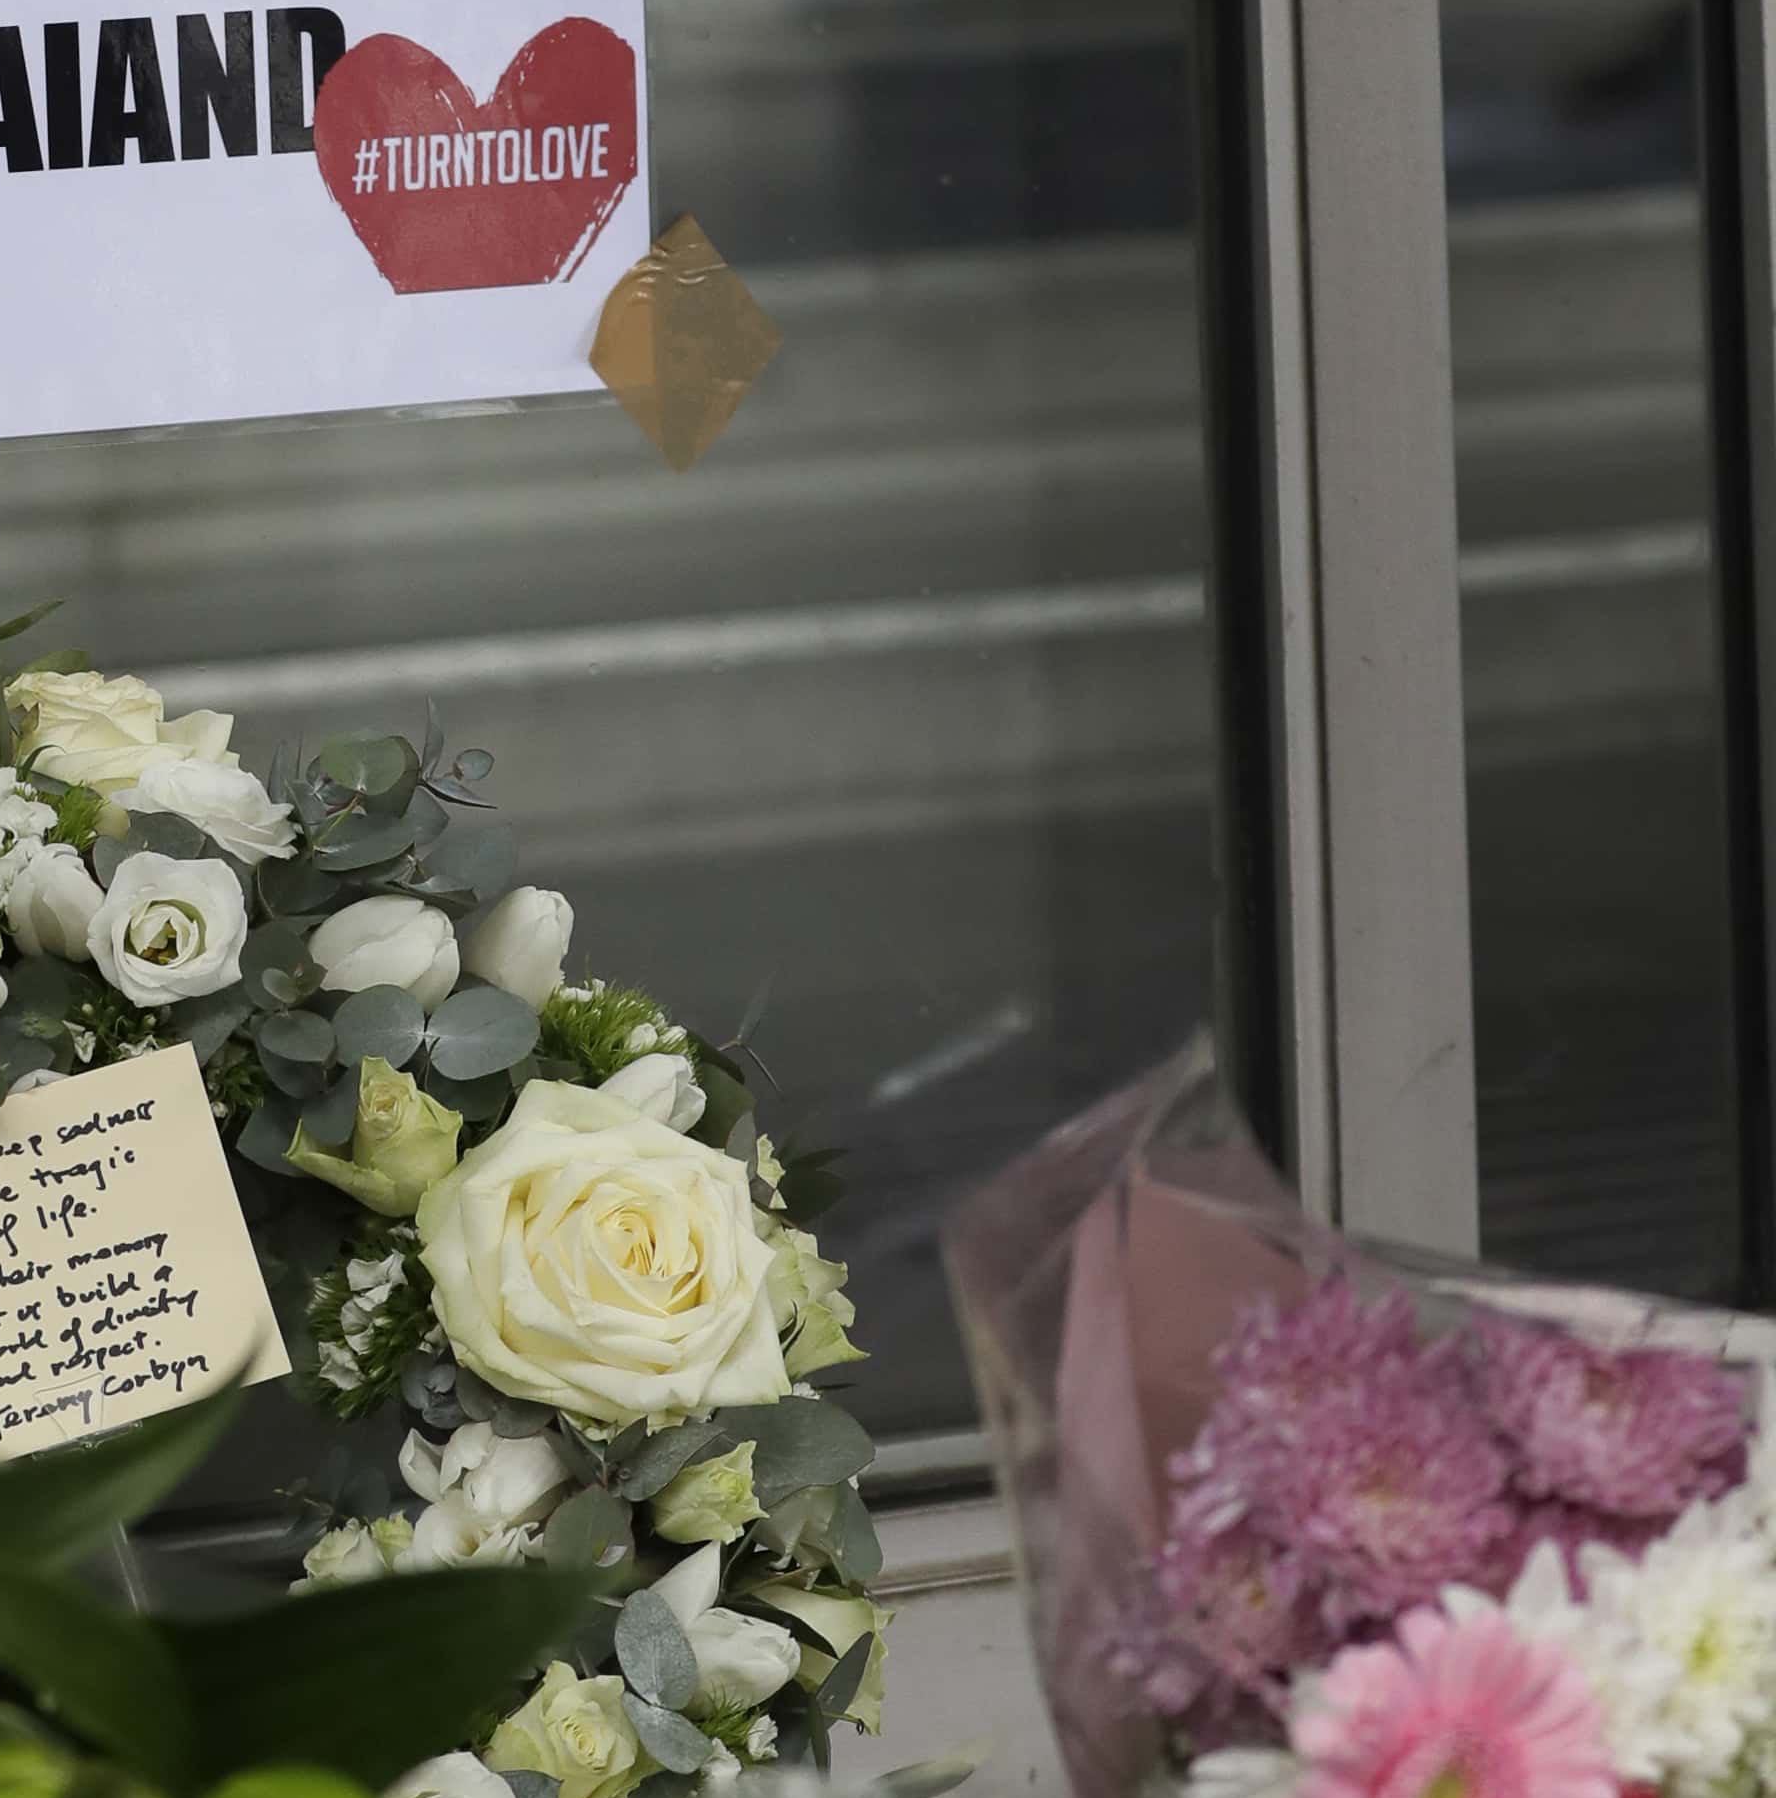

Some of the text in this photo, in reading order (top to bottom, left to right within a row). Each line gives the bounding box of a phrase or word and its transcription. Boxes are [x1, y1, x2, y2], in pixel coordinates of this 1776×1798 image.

[352, 124, 609, 194] #TURNTOLOVE
[57, 1100, 155, 1144] sadness
[29, 1146, 136, 1191] tragic
[36, 1194, 97, 1238] life.
[67, 1233, 169, 1270] memory
[17, 1302, 42, 1322] us
[56, 1272, 140, 1308] build
[154, 1265, 174, 1283] a
[50, 1330, 161, 1376] respect.
[60, 1317, 84, 1355] of
[102, 1354, 209, 1396] Corbyn
